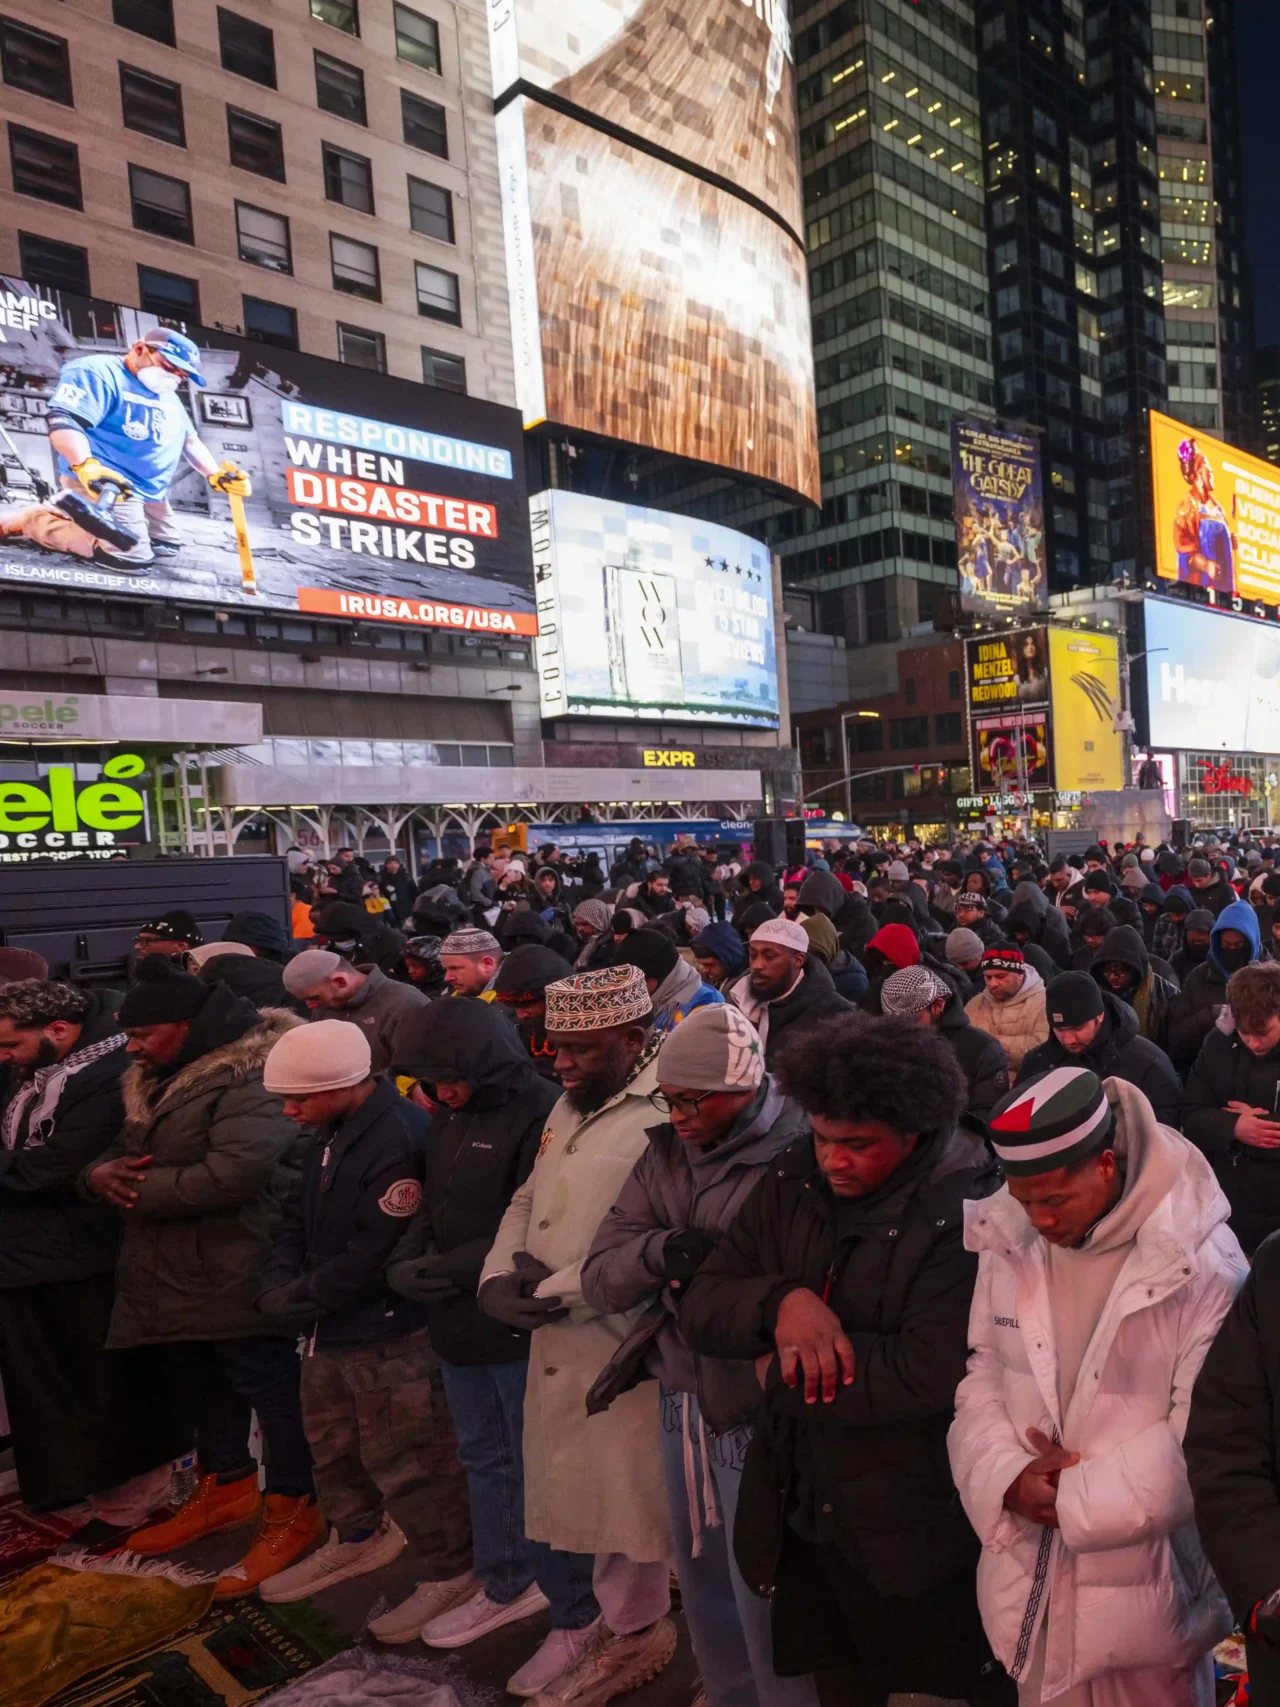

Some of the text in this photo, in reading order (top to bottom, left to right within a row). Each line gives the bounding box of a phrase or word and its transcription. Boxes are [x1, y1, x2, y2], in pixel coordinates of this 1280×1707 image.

[288, 404, 508, 474] RESPONDING
[284, 436, 405, 486] WHEN
[962, 451, 987, 474] THE
[988, 459, 1033, 484] GREAT
[970, 472, 1027, 499] GATSBY
[293, 471, 492, 535] DISASTER
[290, 512, 476, 569] STRIKES
[5, 564, 160, 592] ISLAMIC RELIEF USA
[339, 594, 517, 631] IRUSA.ORG/USA
[536, 596, 563, 703] COLOR
[978, 642, 1007, 661] IDINA
[973, 658, 1014, 681] MENZEL
[972, 681, 1018, 702] REDWOOD
[13, 721, 65, 730] SOCCER
[1197, 760, 1254, 800] Disney
[957, 797, 983, 808] GIFTS
[1058, 791, 1081, 801] GIFTS
[385, 1199, 419, 1212] MONCLER
